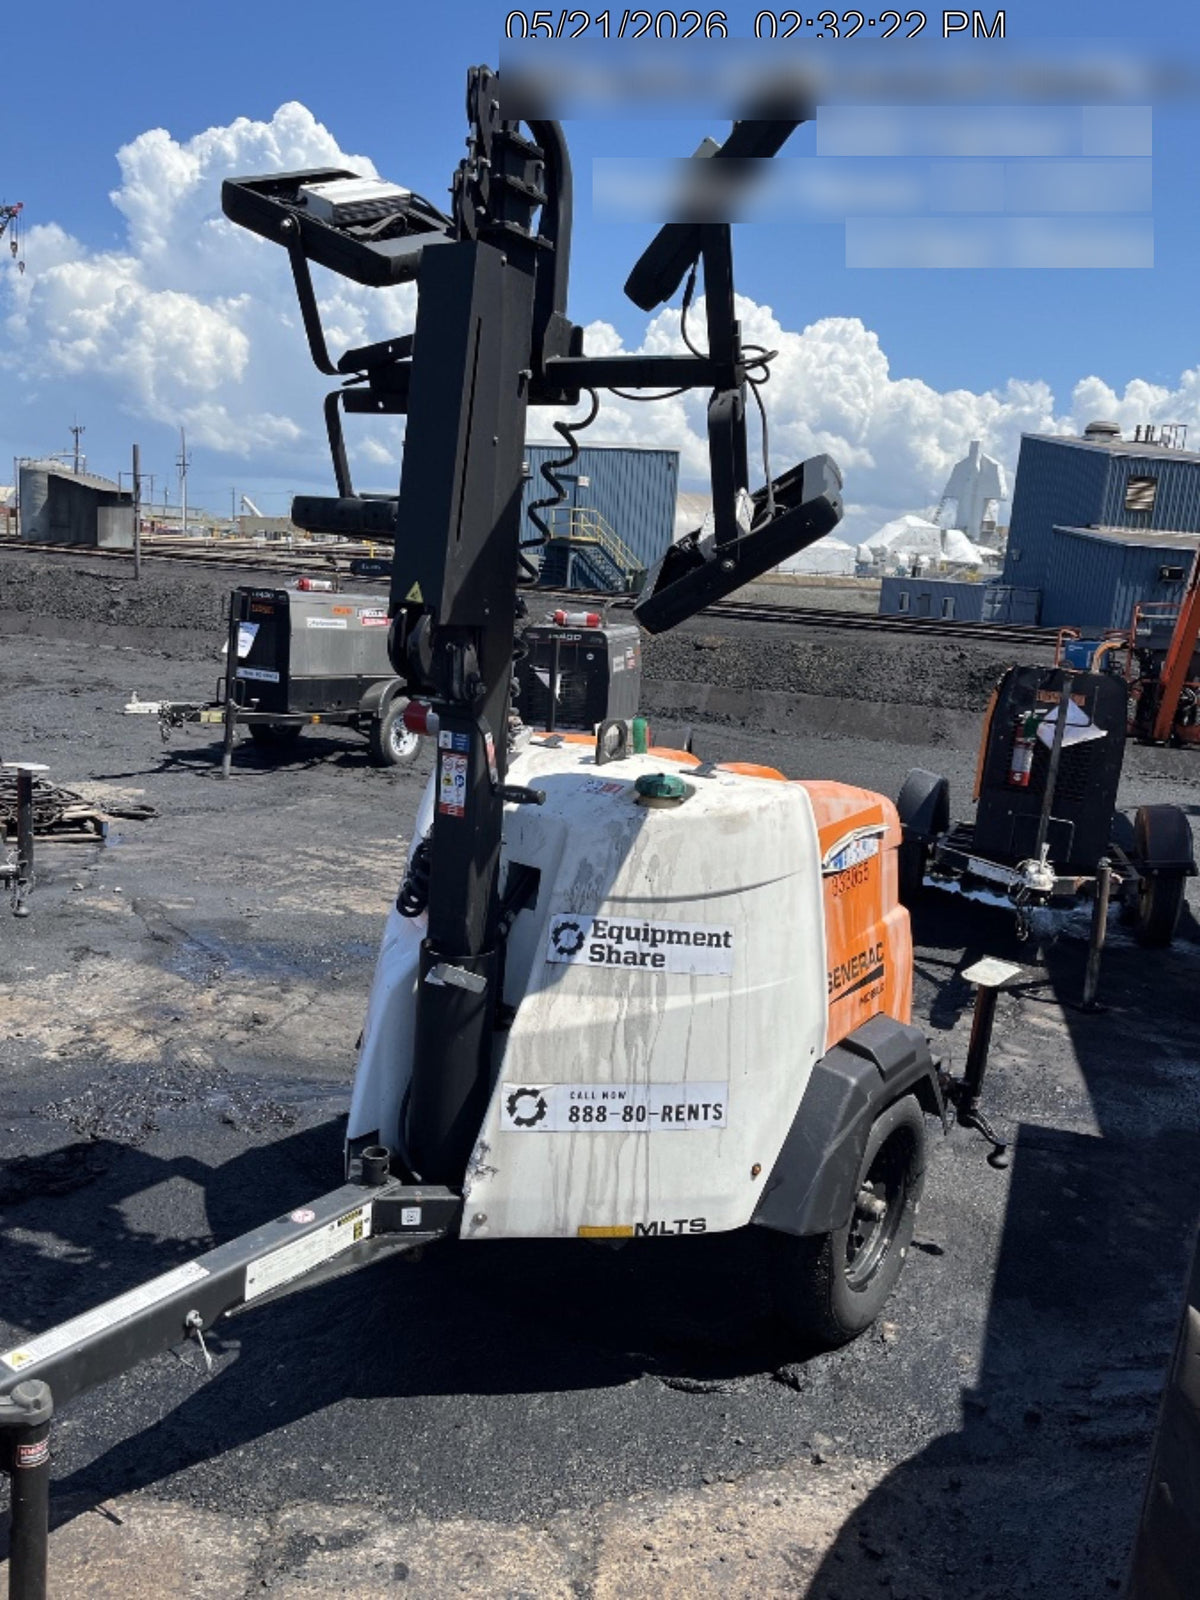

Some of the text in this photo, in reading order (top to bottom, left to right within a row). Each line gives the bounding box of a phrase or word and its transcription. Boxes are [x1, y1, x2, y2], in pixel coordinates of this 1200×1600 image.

[591, 919, 733, 949] Equipment
[588, 944, 666, 968] Share
[570, 1090, 627, 1100] CALL NOW
[568, 1103, 723, 1123] 888-80-RENTS
[635, 1217, 707, 1236] MLTS
